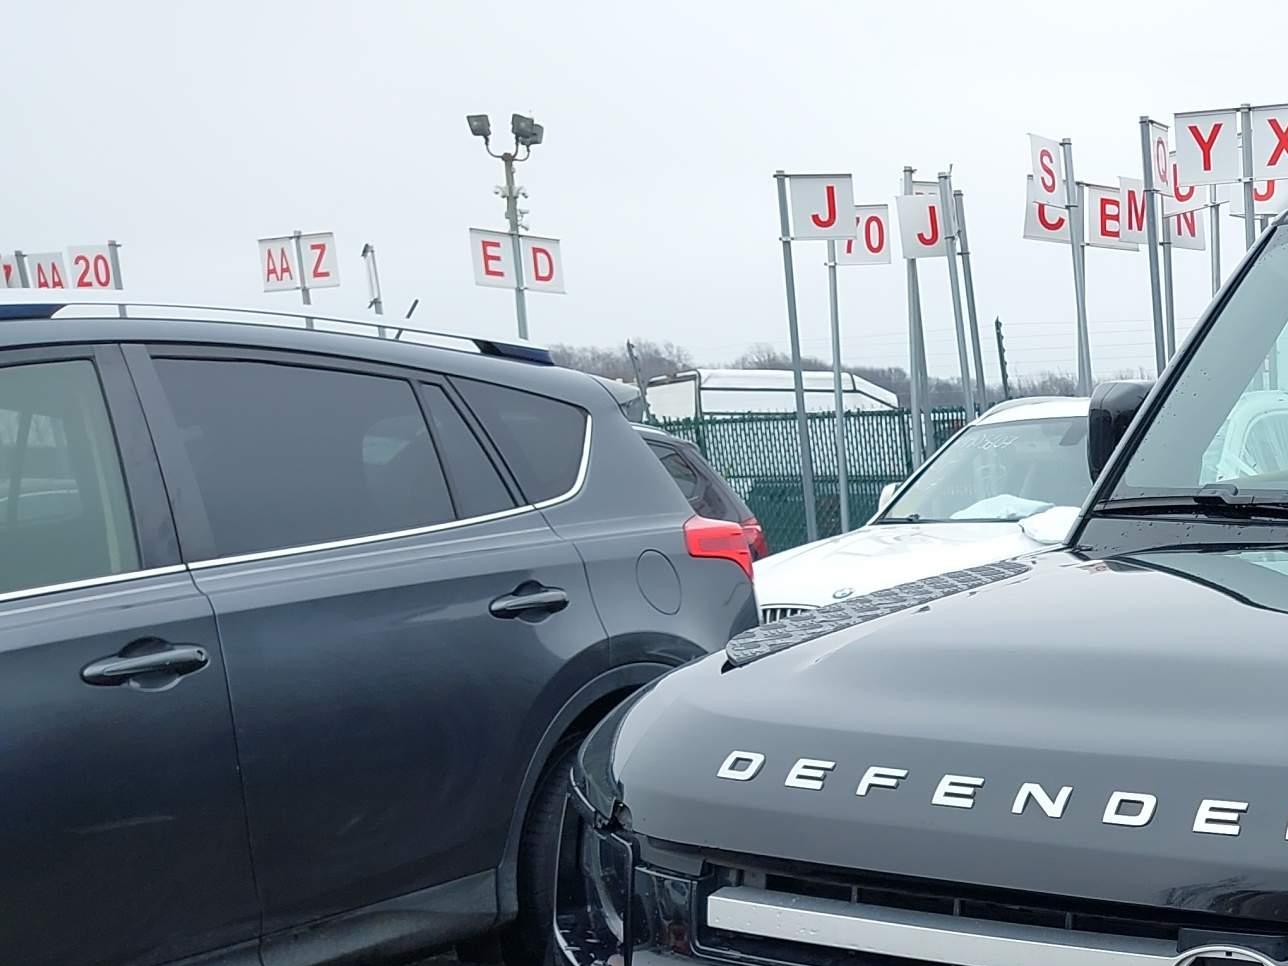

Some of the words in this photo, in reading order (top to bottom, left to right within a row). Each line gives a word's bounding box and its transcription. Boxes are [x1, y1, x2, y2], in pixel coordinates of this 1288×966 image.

[1187, 122, 1224, 172] Y
[1040, 148, 1056, 193] S
[811, 185, 836, 229] J
[916, 205, 939, 247] J
[1100, 197, 1121, 238] B
[73, 254, 111, 288] 20
[265, 247, 293, 282] AA
[310, 243, 331, 279] Z
[481, 240, 504, 277] E
[532, 246, 555, 282] D
